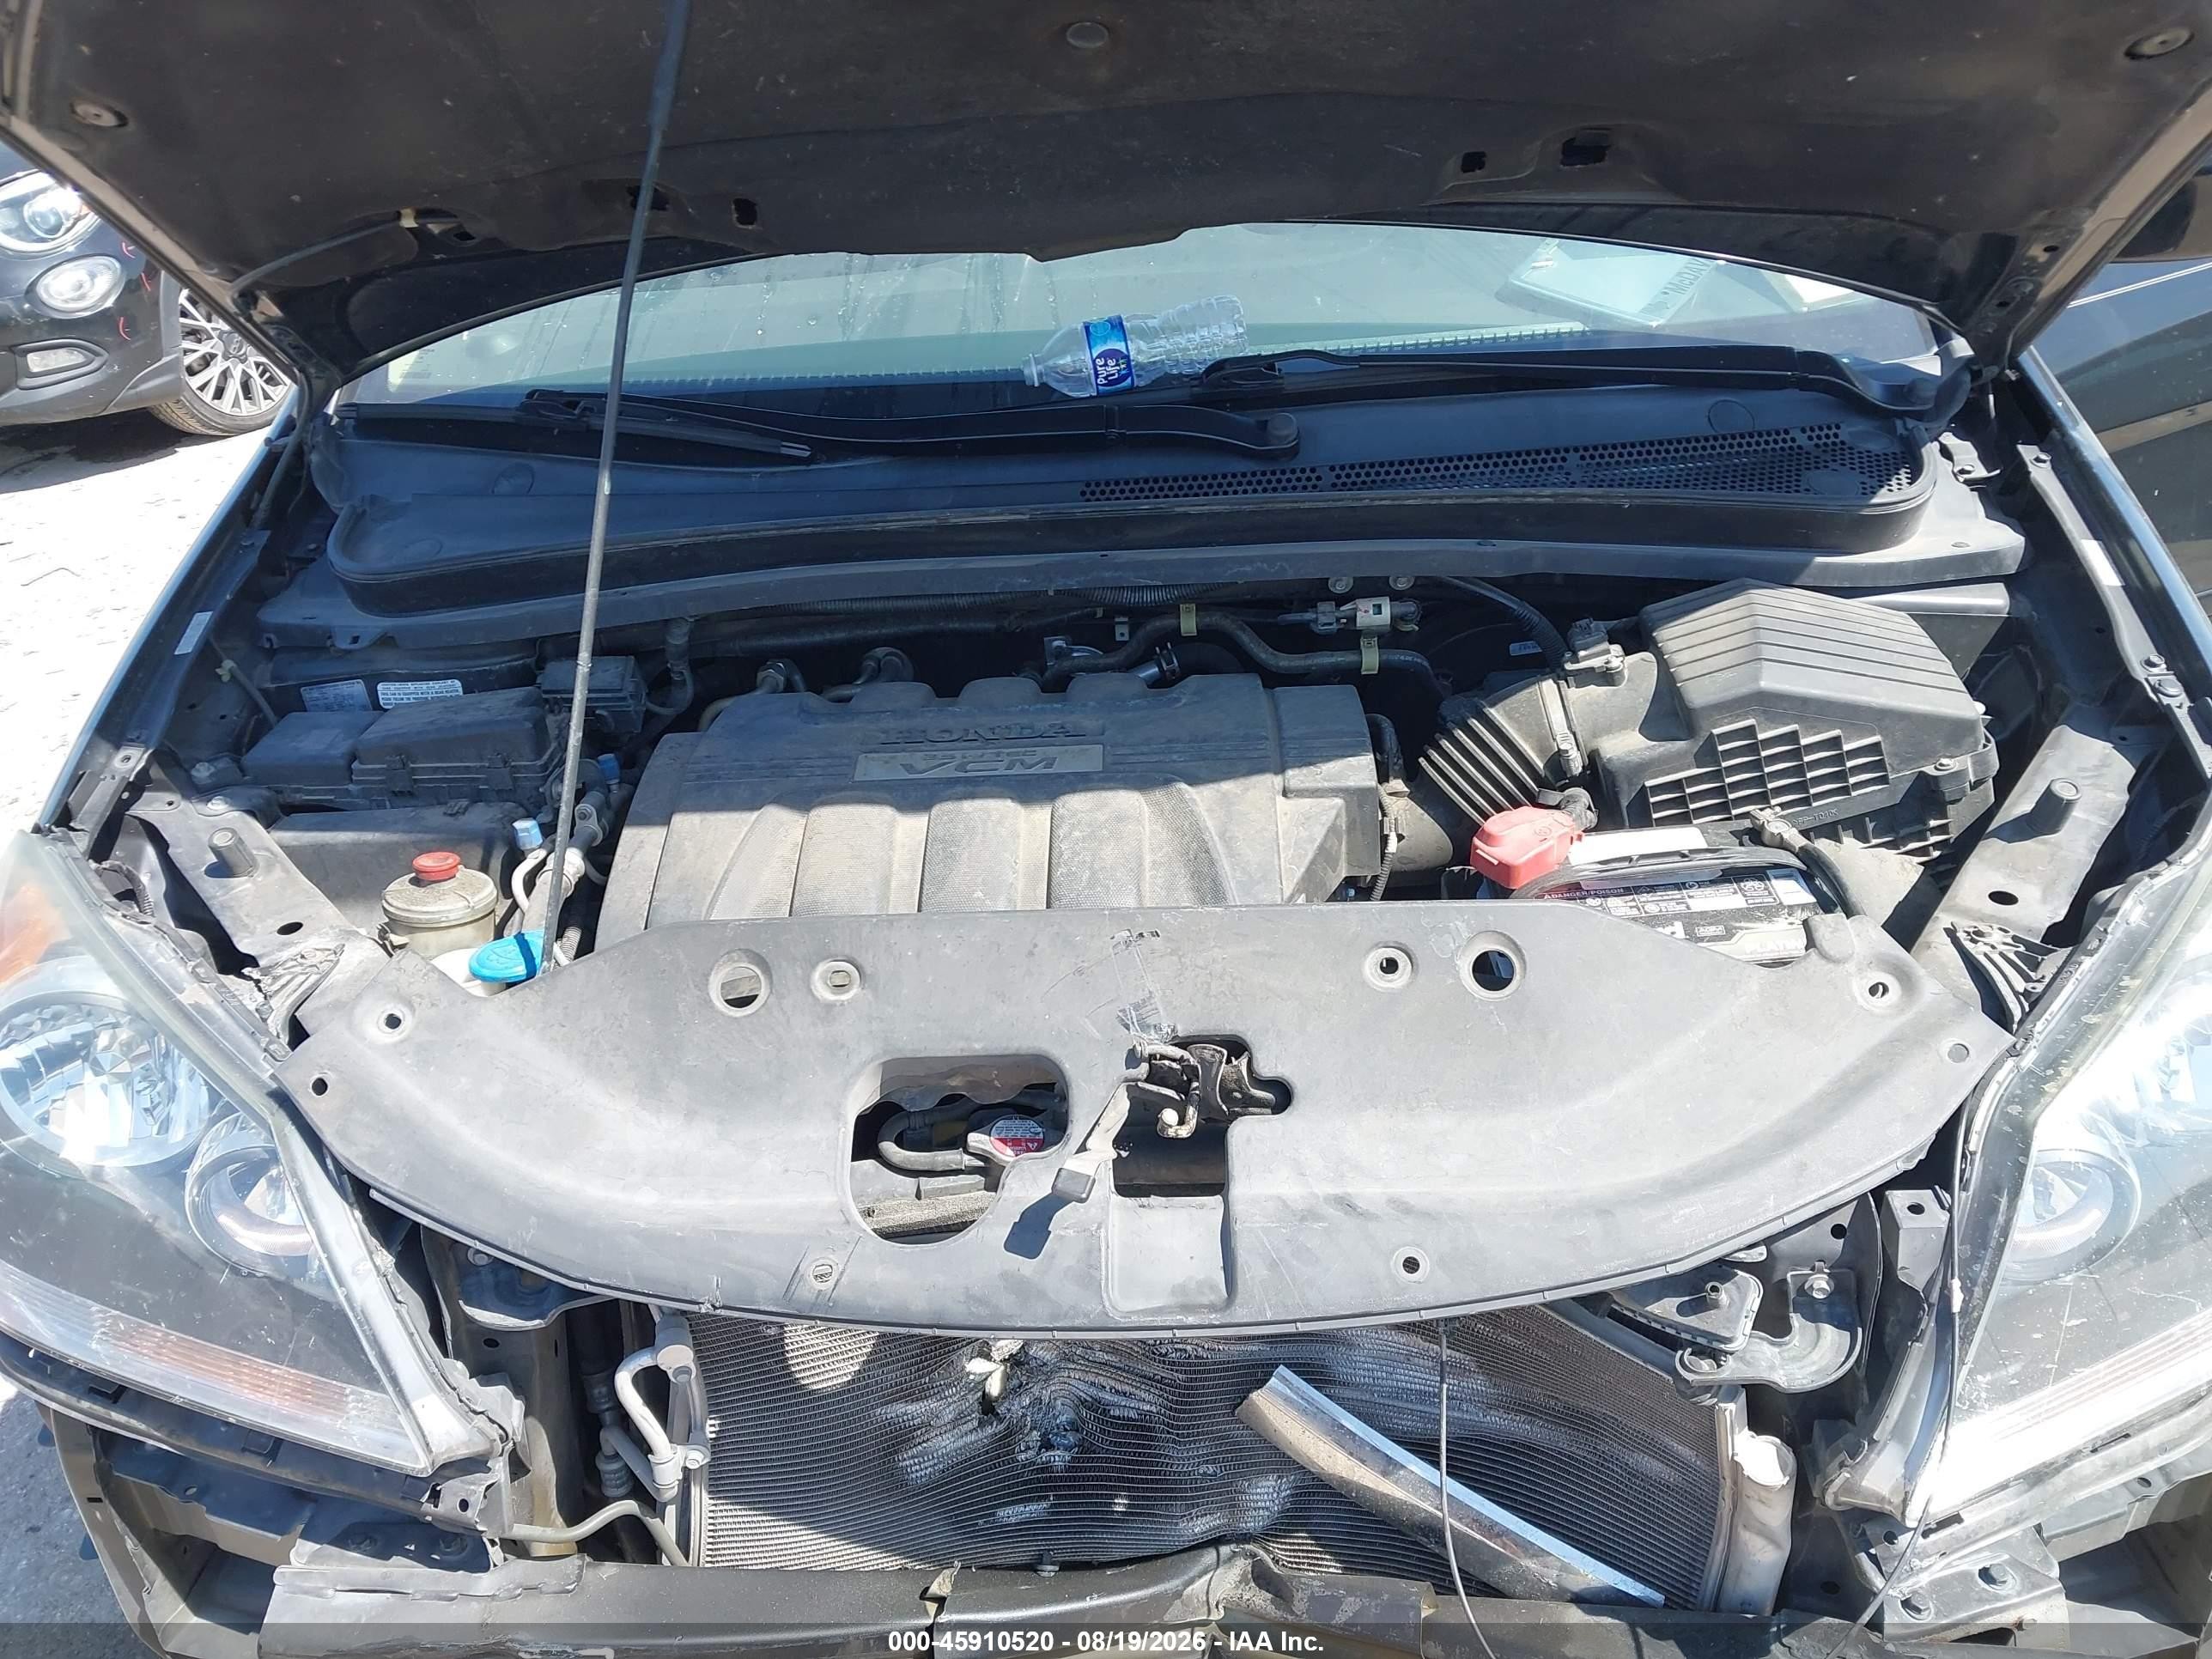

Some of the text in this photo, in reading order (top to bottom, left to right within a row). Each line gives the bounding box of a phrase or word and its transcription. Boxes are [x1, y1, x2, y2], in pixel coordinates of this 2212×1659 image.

[1096, 357, 1108, 385] Pure
[1105, 358, 1120, 380] Life
[879, 722, 1086, 744] HONDA
[899, 757, 1058, 775] VCM
[1551, 888, 1625, 900] DANGER/POISON
